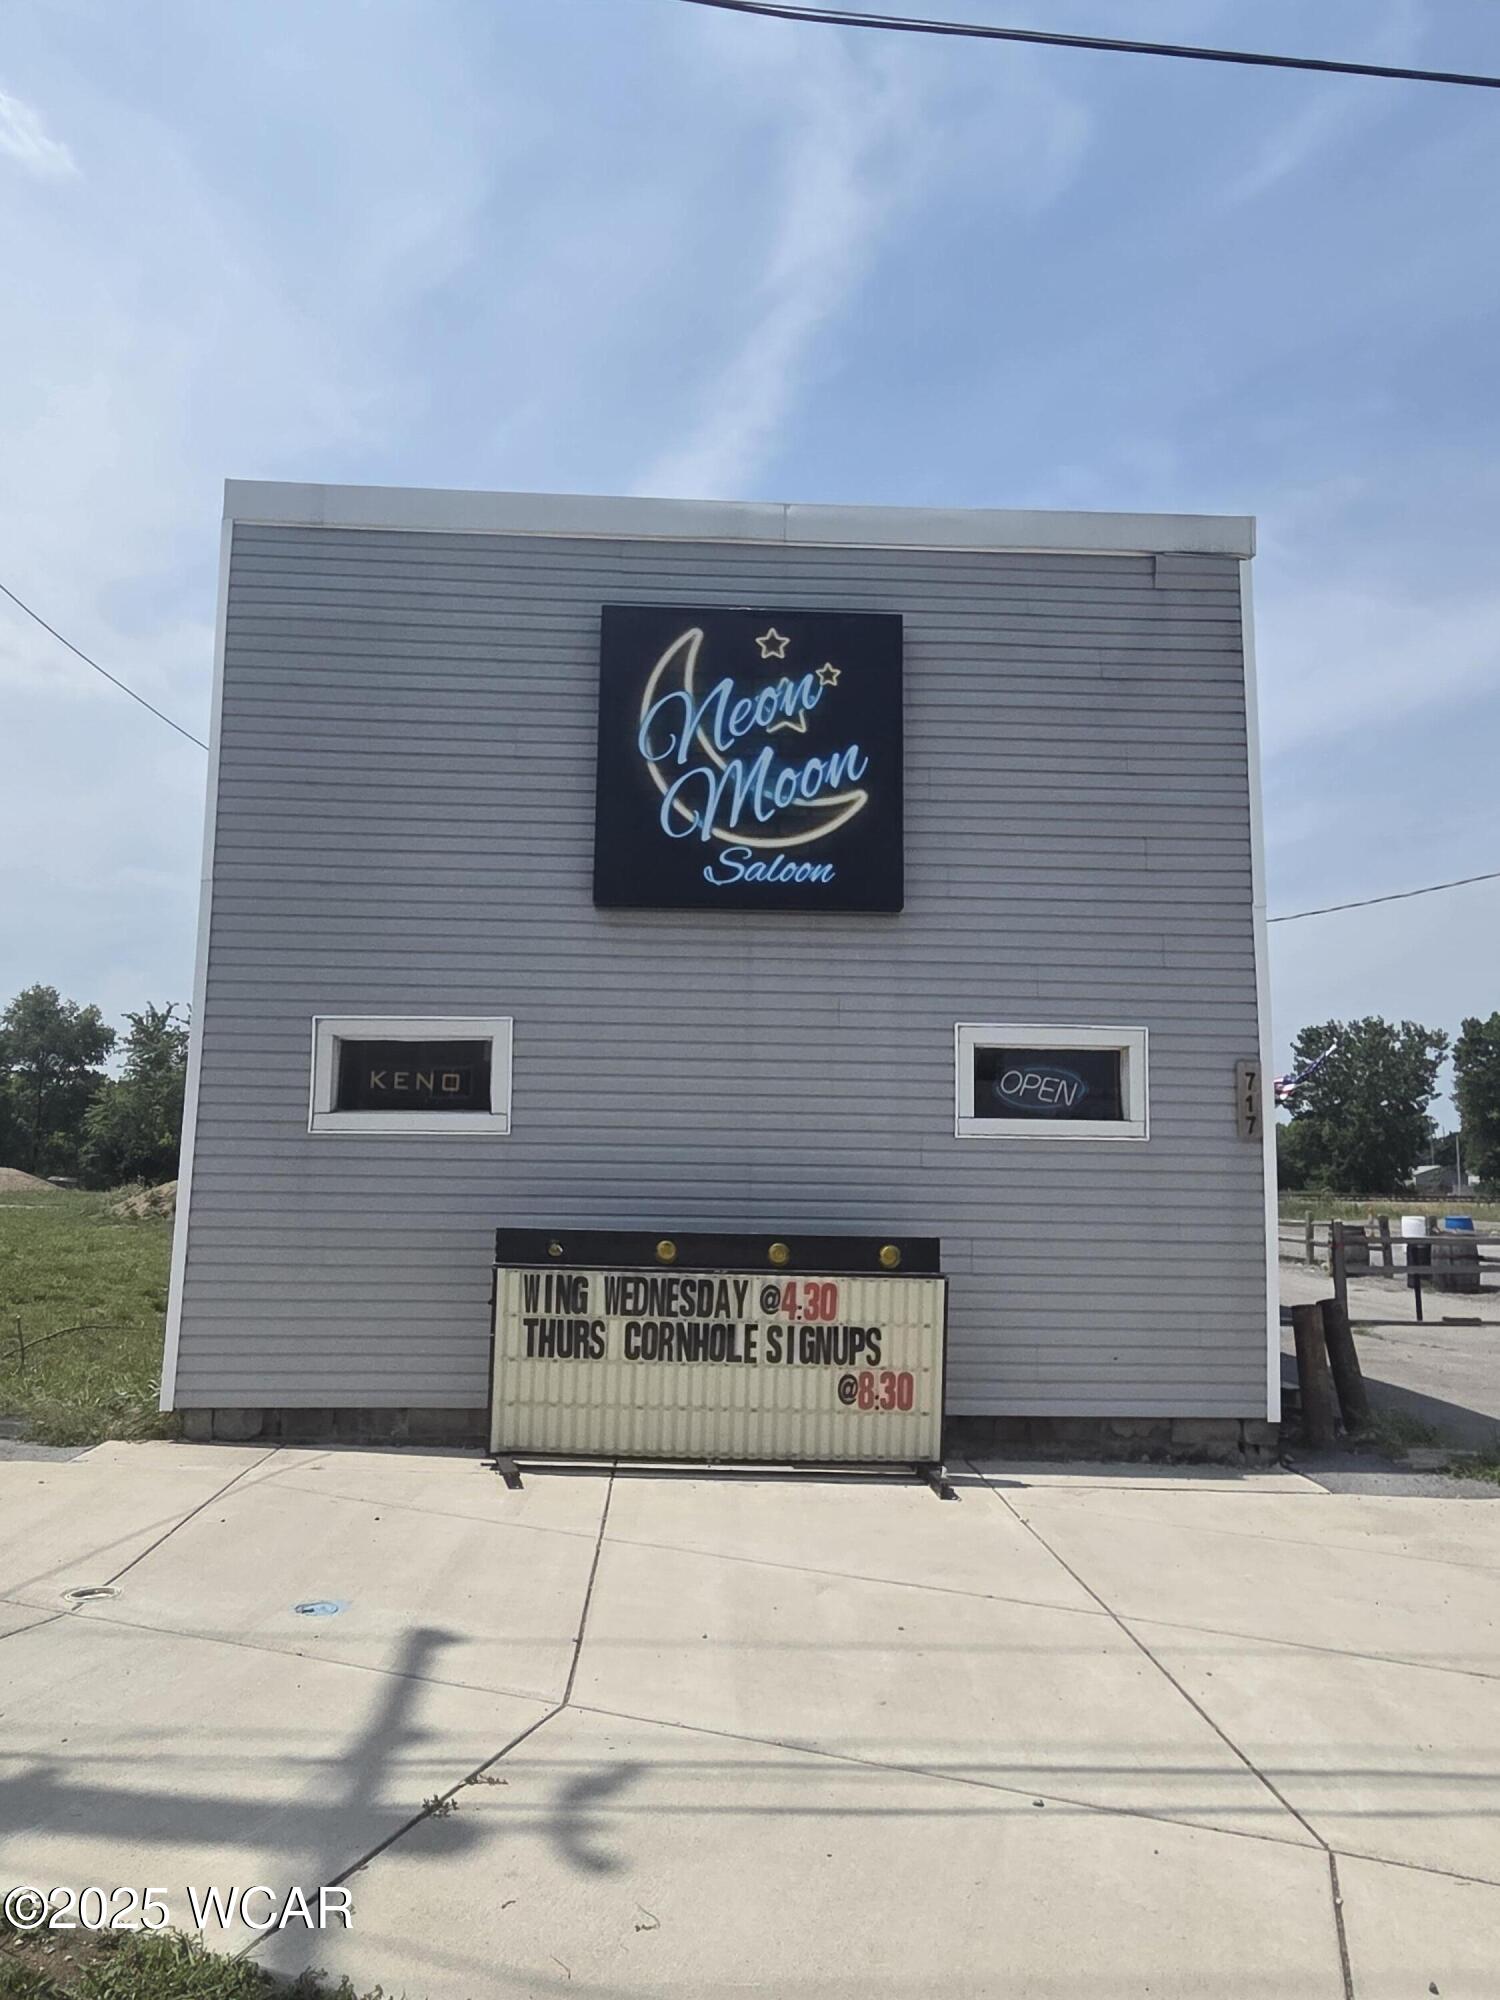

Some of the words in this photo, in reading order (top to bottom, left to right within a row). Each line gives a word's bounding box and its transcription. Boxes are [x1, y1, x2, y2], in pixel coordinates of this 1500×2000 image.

[638, 673, 823, 764] Neon
[660, 745, 868, 841] Moon
[703, 846, 836, 886] Saloon
[369, 1071, 460, 1092] KENO
[1000, 1070, 1078, 1106] OPEN
[523, 1273, 589, 1315] WING
[603, 1276, 749, 1319] WEDNESDAY
[523, 1317, 606, 1360] THURS
[624, 1321, 758, 1364] CORNHOLE
[766, 1325, 882, 1366] SIGNUPS
